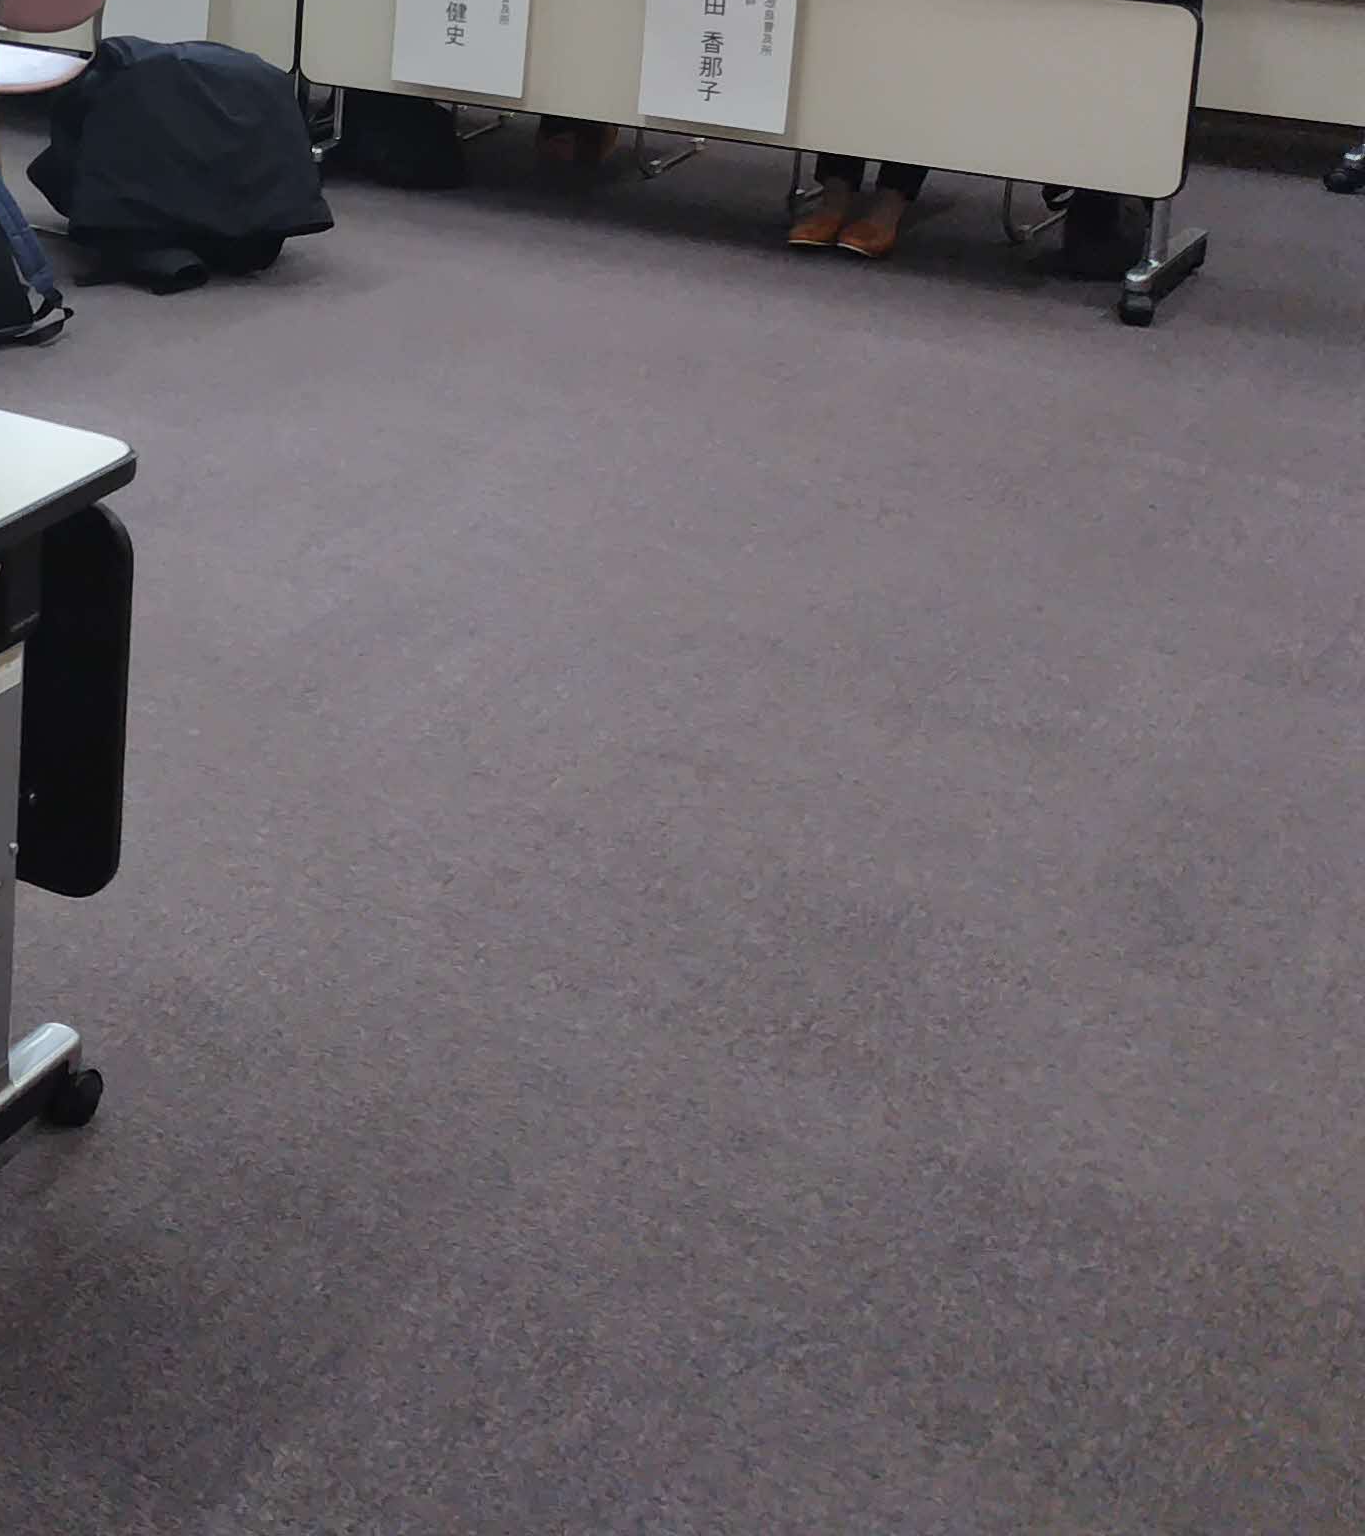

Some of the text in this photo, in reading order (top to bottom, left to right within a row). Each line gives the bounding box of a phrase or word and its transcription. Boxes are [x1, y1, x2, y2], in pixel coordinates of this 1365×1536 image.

[444, 1, 468, 47] 健史
[698, 30, 726, 103] 香那子
